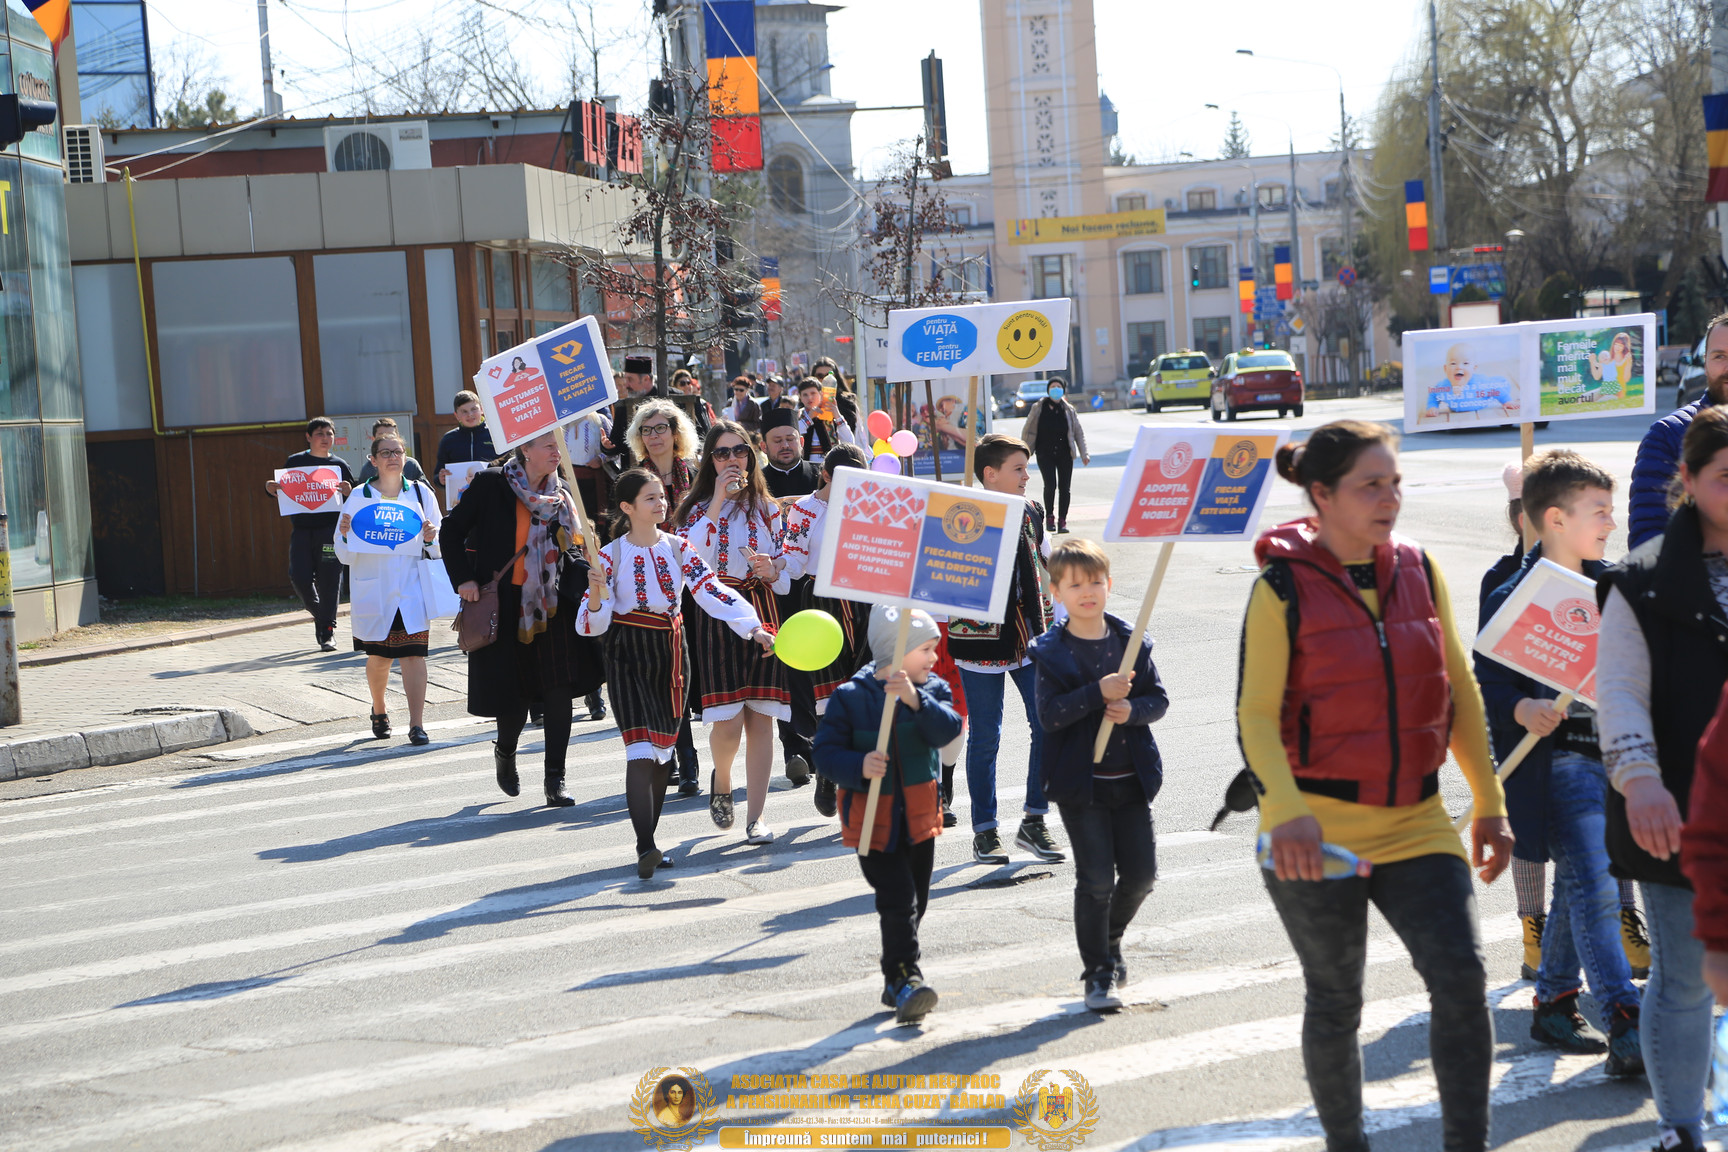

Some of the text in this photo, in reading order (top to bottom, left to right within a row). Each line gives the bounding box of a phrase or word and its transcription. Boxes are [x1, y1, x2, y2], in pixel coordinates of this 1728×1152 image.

[1003, 317, 1015, 330] Sunt
[1015, 312, 1035, 321] pentru
[938, 343, 959, 351] pentru
[1557, 338, 1597, 351] Femeile
[916, 349, 962, 362] FEMEIE
[560, 363, 585, 378] FIECARE
[1557, 362, 1577, 373] mai
[566, 373, 585, 384] COPIL
[1557, 372, 1582, 384] mult
[558, 375, 598, 396] ARE DREPTUL
[1428, 386, 1451, 394] Inima
[563, 394, 572, 402] LA
[1487, 389, 1500, 397] zile
[510, 396, 540, 414] PENTRU
[1558, 393, 1594, 406] avortul
[306, 481, 337, 490] FEMEIE
[1214, 486, 1248, 494] FIECARE
[295, 494, 327, 502] FAMILIE
[1138, 496, 1190, 506] O ALEGERE
[1141, 508, 1178, 520] NOBILĂ
[1199, 507, 1219, 515] ESTE
[1219, 507, 1230, 515] UN
[364, 530, 405, 541] FEMEIE
[852, 533, 904, 548] LIFE, LIBERTY
[842, 541, 911, 559] AND THE PURSUIT
[924, 546, 994, 566] FIECARE COPIL
[848, 553, 904, 568] OF HAPPINESS
[857, 564, 891, 576] FOR ALL.
[926, 559, 989, 577] ARE DREPTUL
[931, 571, 944, 581] LA
[1533, 624, 1587, 652] O LUME
[1523, 633, 1581, 663] PENTRU
